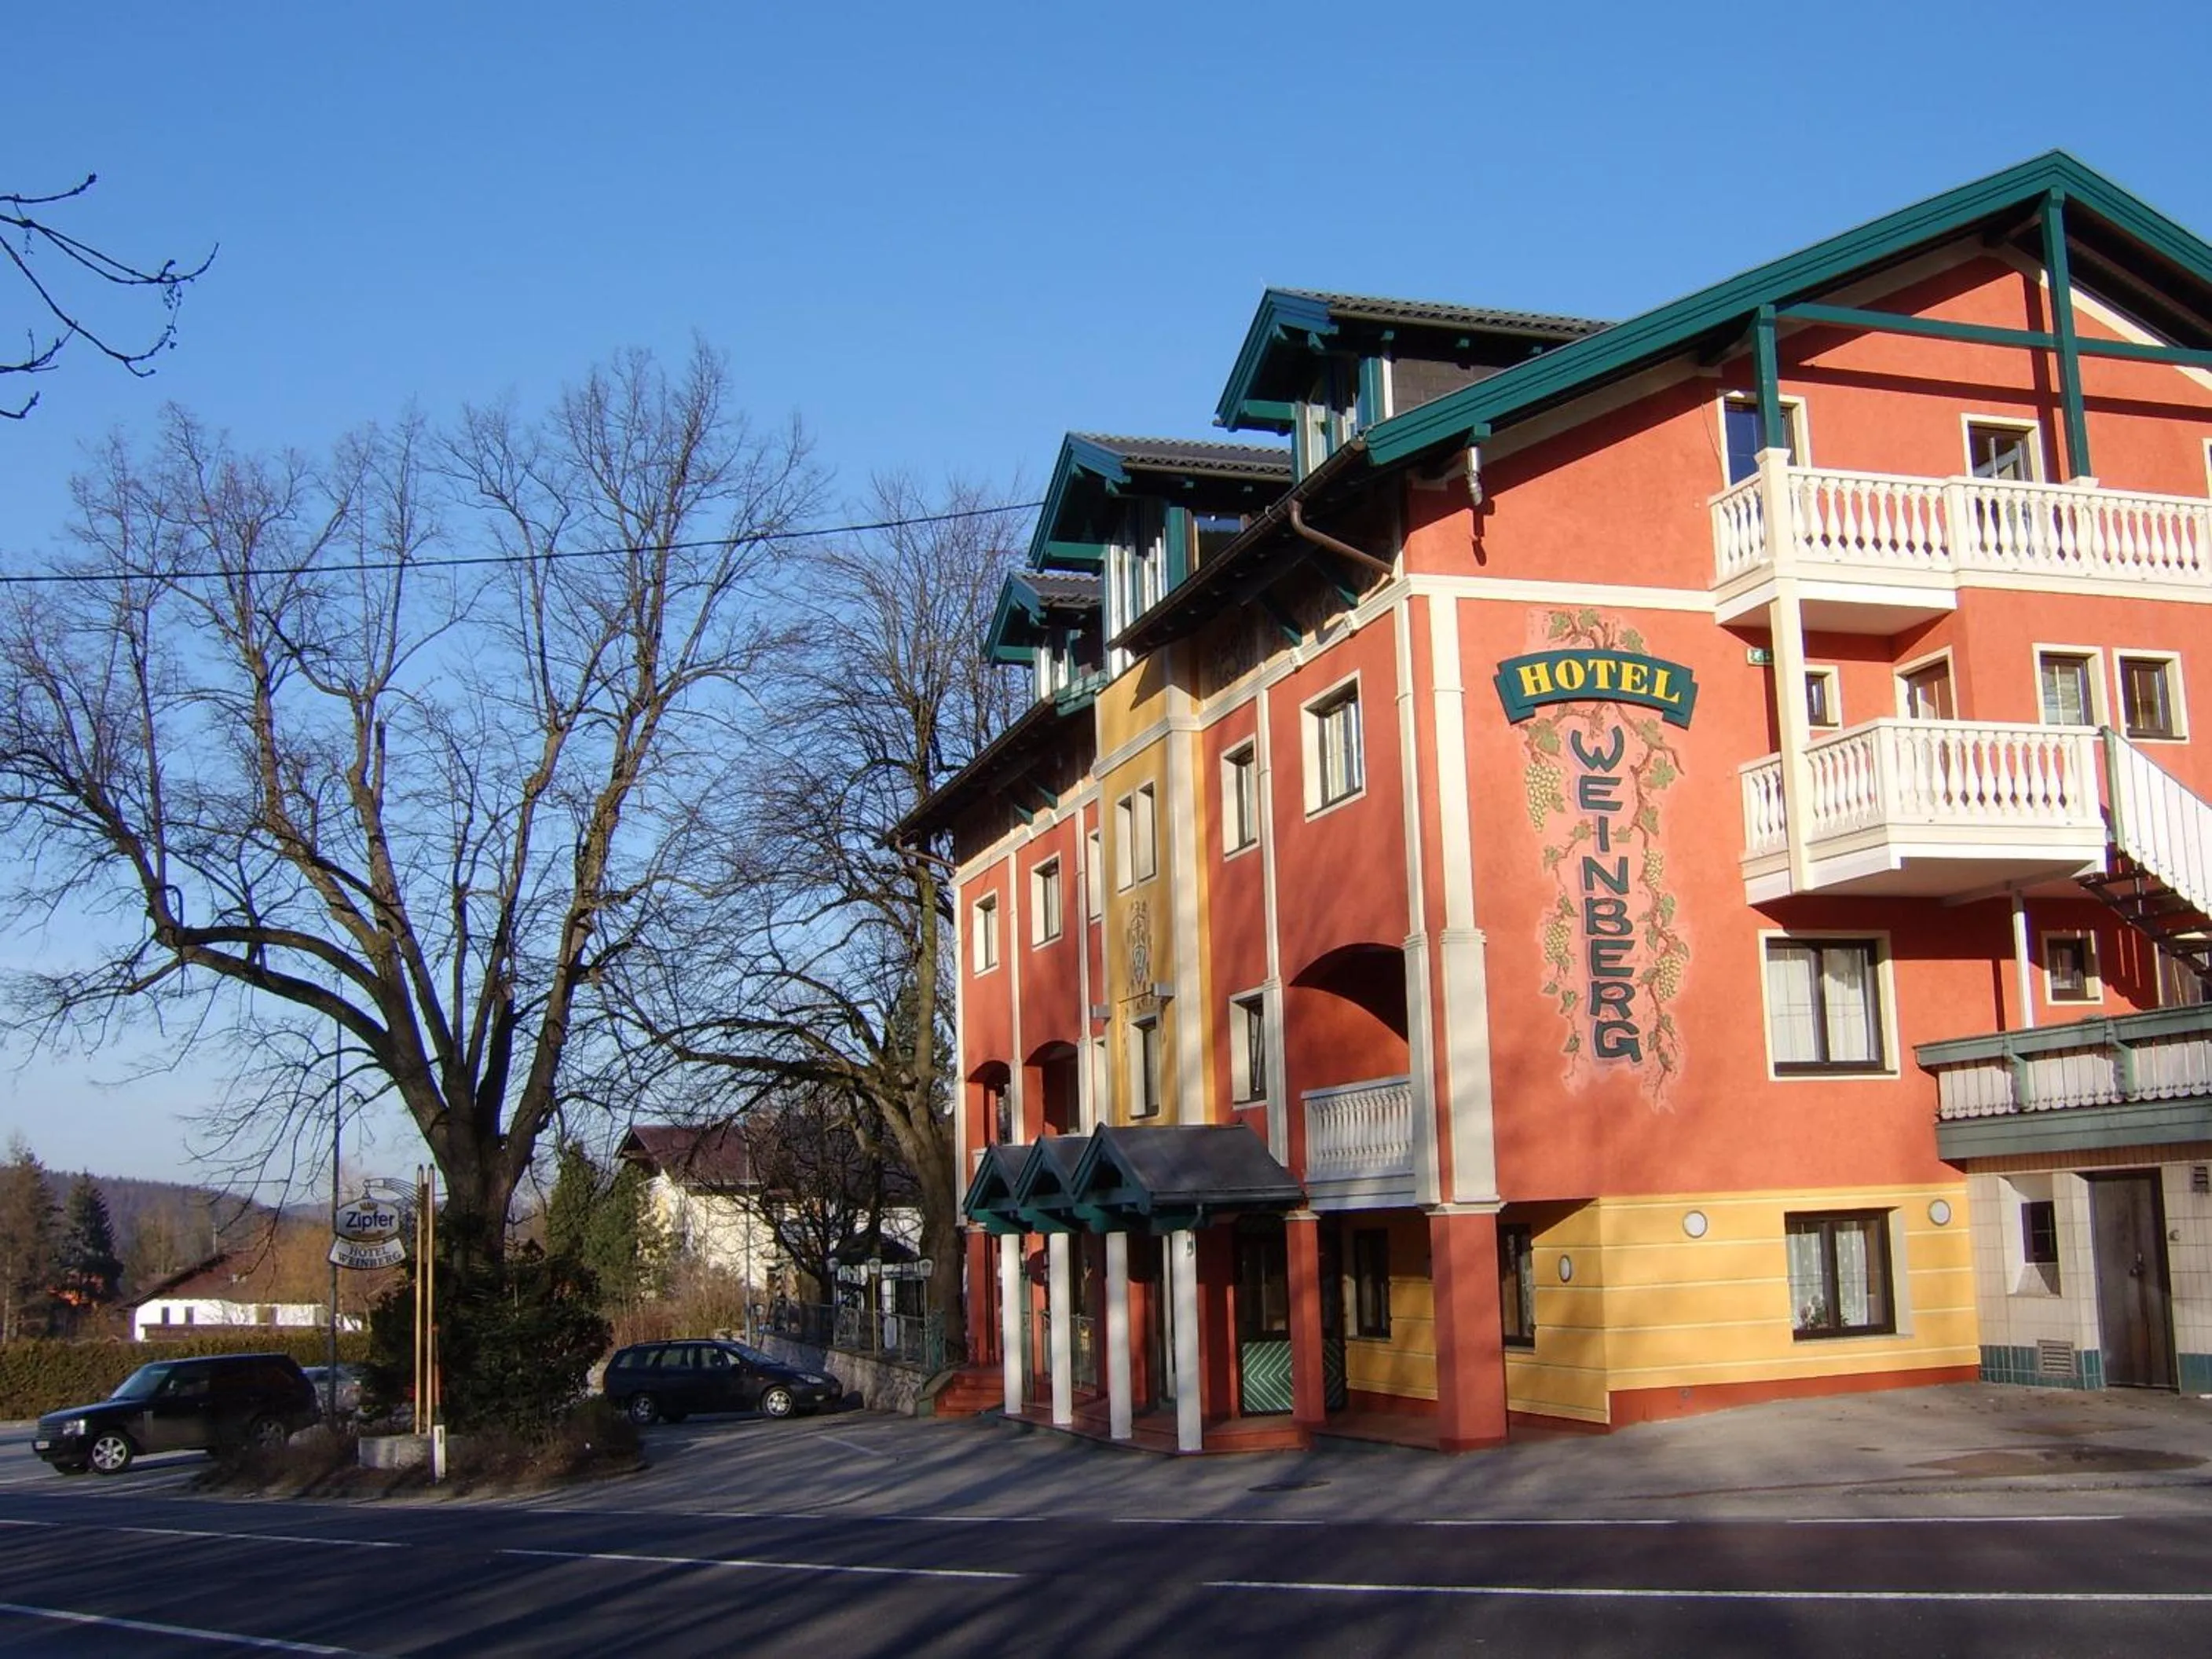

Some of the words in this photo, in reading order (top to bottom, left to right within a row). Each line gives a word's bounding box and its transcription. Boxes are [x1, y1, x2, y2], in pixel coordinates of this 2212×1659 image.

[1516, 659, 1680, 703] HOTEL
[1571, 725, 1643, 1064] WEINBERG
[346, 1210, 394, 1231] Zipfer
[339, 1251, 401, 1267] WEINBERG
[350, 1247, 390, 1257] HOTEL
